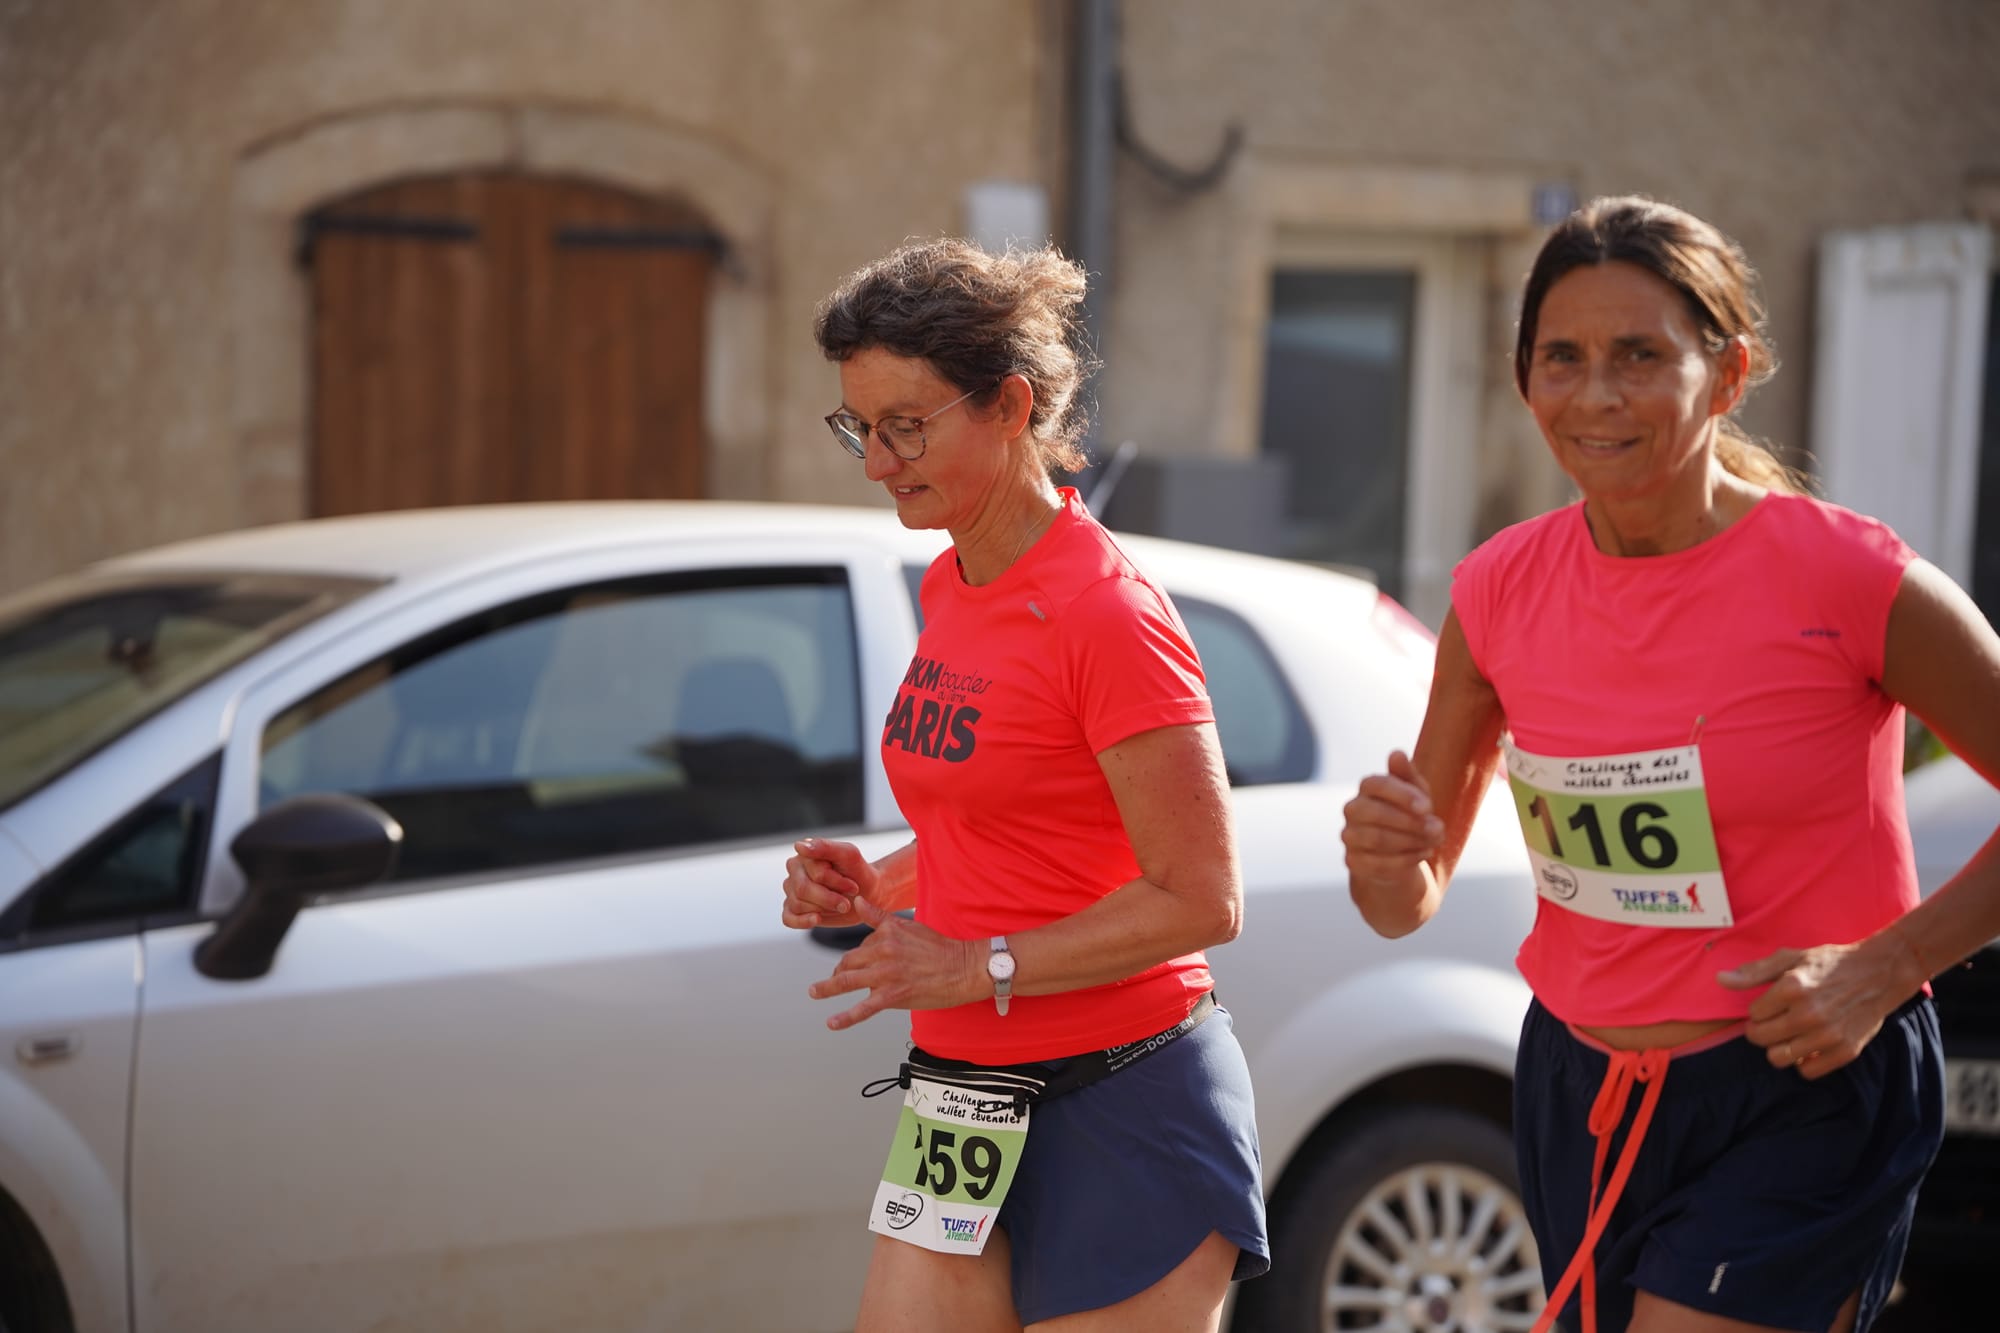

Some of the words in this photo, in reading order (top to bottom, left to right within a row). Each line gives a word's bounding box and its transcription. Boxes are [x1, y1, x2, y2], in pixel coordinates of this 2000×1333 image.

[1566, 760, 1641, 776] Challenge
[1653, 754, 1678, 768] des
[1527, 794, 1680, 870] 116
[936, 1105, 967, 1118] vallées
[885, 1200, 917, 1220] BFP
